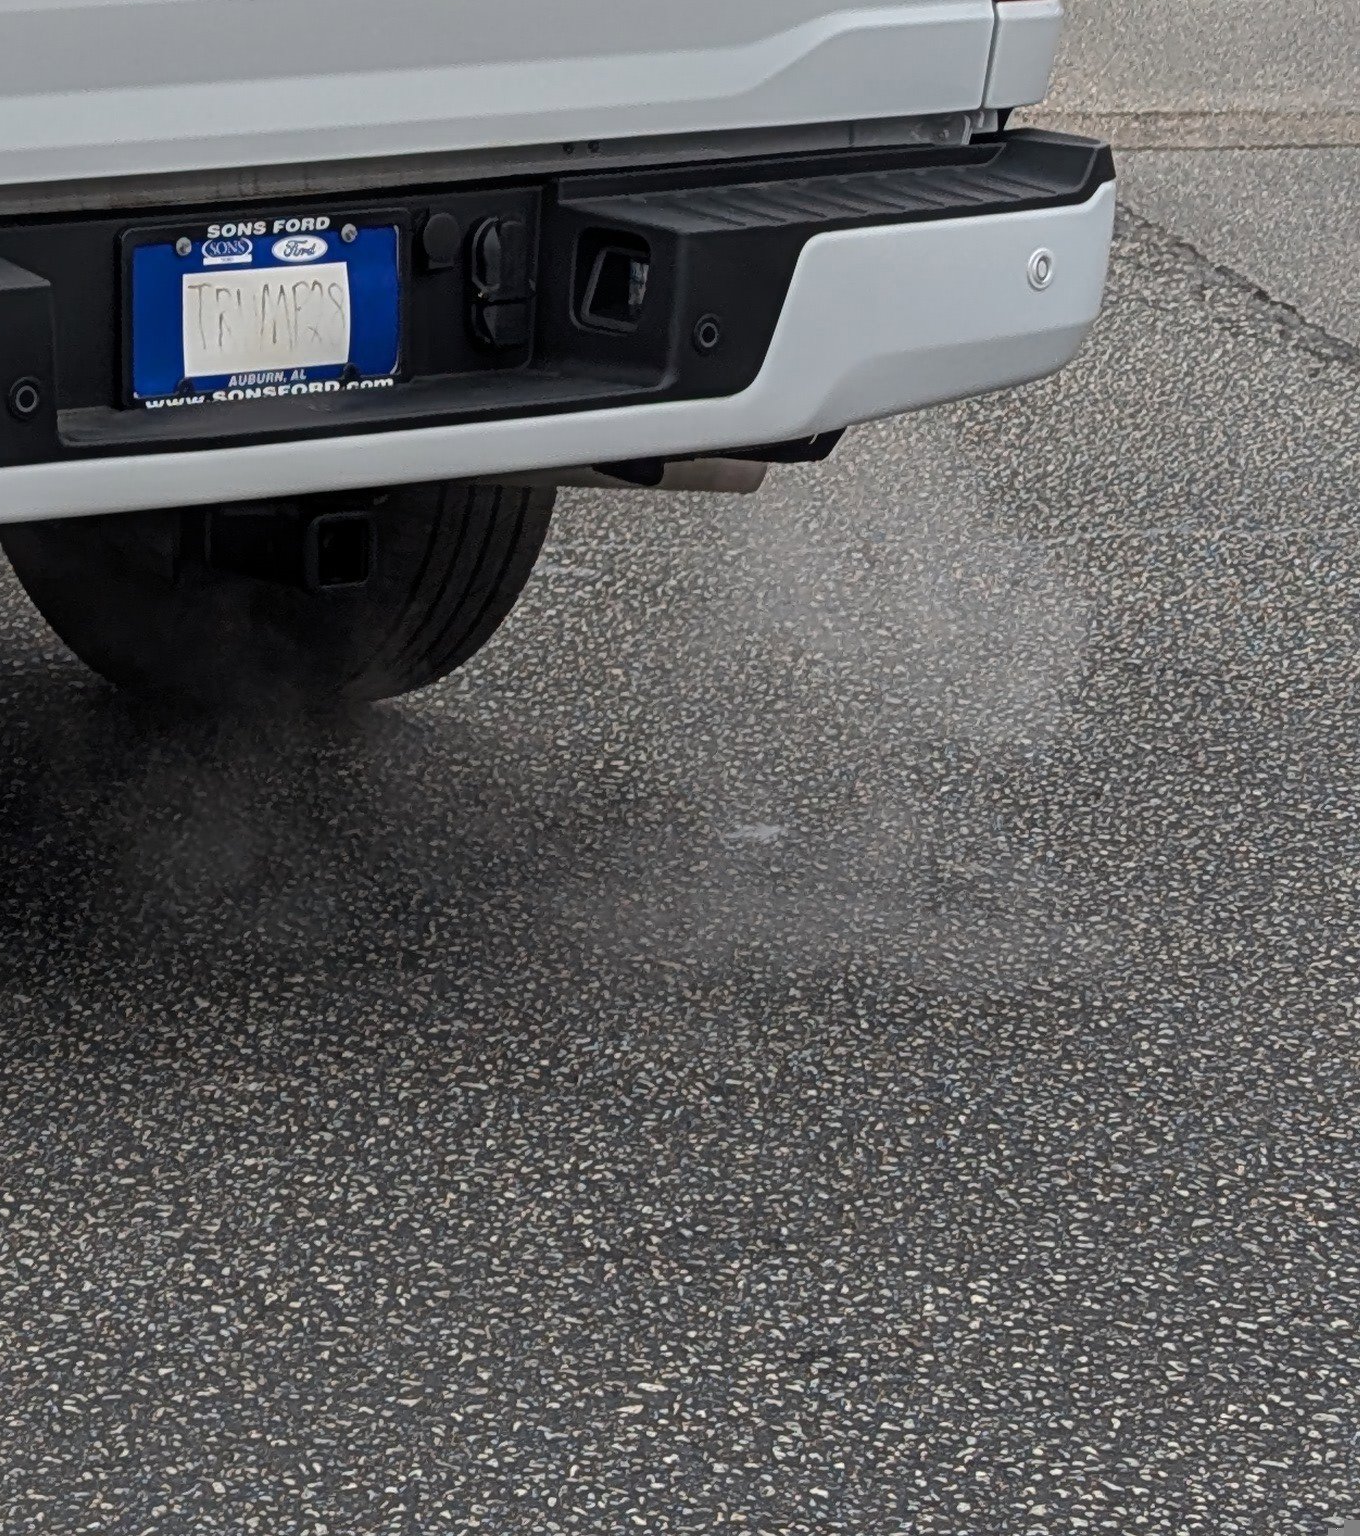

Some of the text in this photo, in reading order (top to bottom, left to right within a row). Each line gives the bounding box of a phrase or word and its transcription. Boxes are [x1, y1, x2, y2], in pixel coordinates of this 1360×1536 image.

[207, 216, 330, 239] SONS FORD
[209, 240, 246, 255] SONS
[283, 240, 317, 257] Ford
[228, 369, 307, 387] AUBURN, AL
